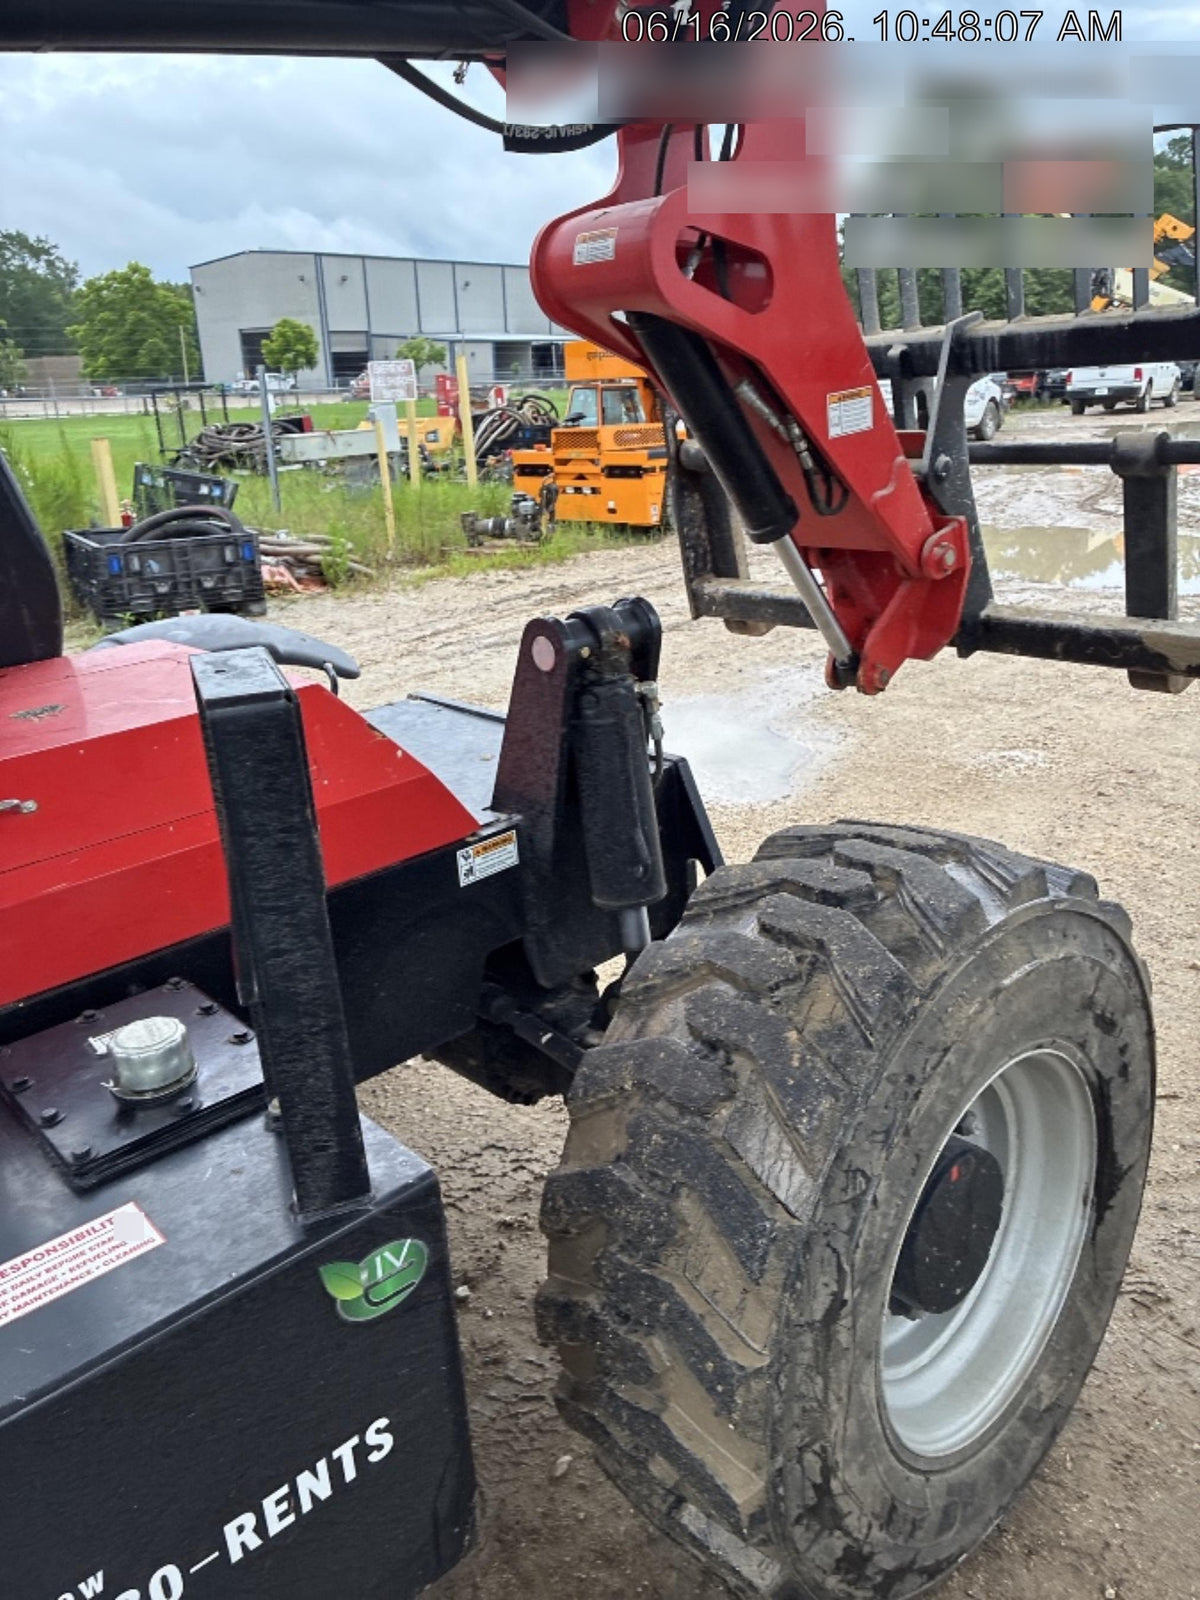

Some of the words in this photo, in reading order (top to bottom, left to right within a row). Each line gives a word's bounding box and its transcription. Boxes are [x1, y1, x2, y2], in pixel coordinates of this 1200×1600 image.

[11, 1275, 59, 1302] DAMAGE
[12, 1267, 94, 1312] MAINTENANCE
[103, 1237, 155, 1267] CLEANING
